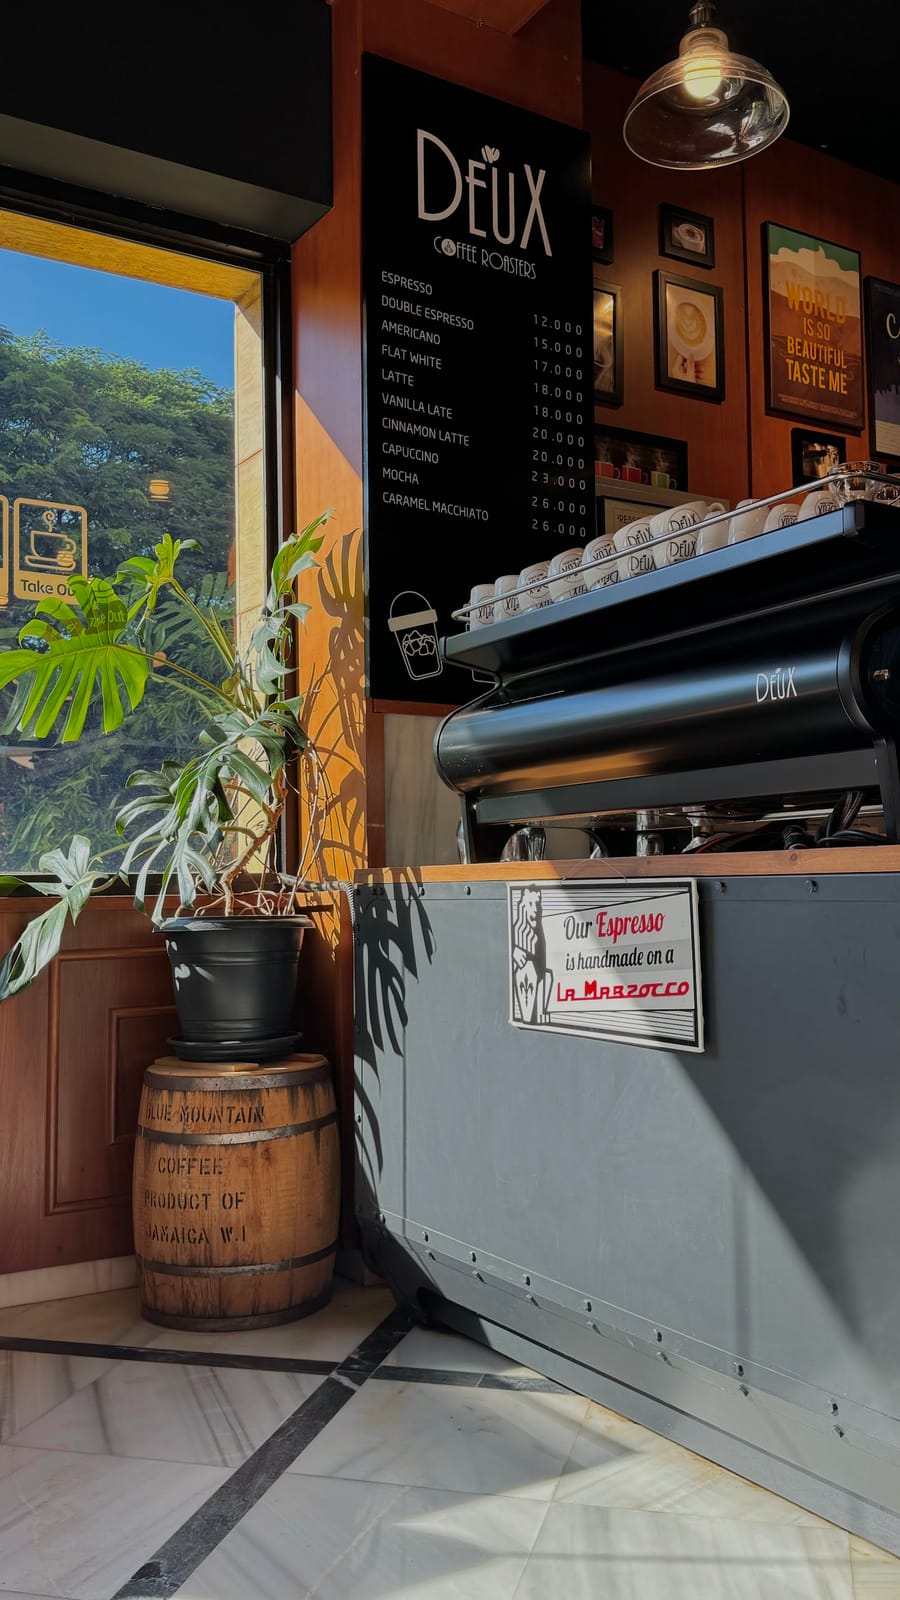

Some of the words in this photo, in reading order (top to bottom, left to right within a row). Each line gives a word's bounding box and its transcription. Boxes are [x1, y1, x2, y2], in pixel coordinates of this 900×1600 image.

[417, 128, 552, 257] DEUX
[433, 235, 477, 264] COFFEE
[482, 248, 537, 280] ROASTERS
[381, 270, 433, 296] ESPRESSO
[381, 294, 422, 317] DOUBLE
[424, 306, 474, 331] ESPRESSO
[785, 279, 847, 324] WORLD
[381, 319, 441, 345] AMERICANO
[533, 313, 582, 336] 12.000
[803, 316, 814, 337] IS
[816, 322, 831, 342] SO
[381, 343, 408, 361] FLAT
[410, 351, 442, 370] WHITE
[533, 336, 583, 358] 15.000
[786, 335, 848, 370] BEAUTIFUL
[381, 368, 415, 387] LATTE
[533, 359, 583, 380] 17.000
[785, 358, 826, 390] TASTE
[828, 370, 848, 395] ME
[533, 381, 583, 403] 18.000
[381, 392, 425, 414] VANILLA
[427, 403, 453, 420] LATE
[533, 405, 583, 425] 18.000
[381, 417, 436, 439] CINNAMON
[438, 429, 470, 447] LATTE
[532, 427, 585, 448] 20.000
[382, 441, 439, 464] CAPUCCINO
[532, 449, 585, 470] 20.000
[382, 466, 419, 485] MOCHA
[531, 470, 586, 491] 23.000
[382, 491, 430, 511] CARAMEL
[432, 501, 489, 521] MACCHIATO
[531, 496, 586, 515] 26.000
[531, 518, 586, 537] 26.000
[20, 579, 53, 595] Take
[56, 583, 75, 596] Ou
[756, 667, 798, 703] DEUX
[563, 915, 593, 941] Our
[595, 911, 666, 944] Espresso
[565, 952, 575, 971] is
[577, 947, 643, 970] handmade
[646, 950, 662, 966] on
[665, 948, 674, 964] a
[145, 1103, 172, 1121] BLUE
[178, 1104, 265, 1124] MOUNTAIN
[158, 1156, 224, 1175] COFFEE
[144, 1191, 212, 1210] PRODUCT
[221, 1191, 247, 1210] OF
[146, 1225, 210, 1244] JAMAICA
